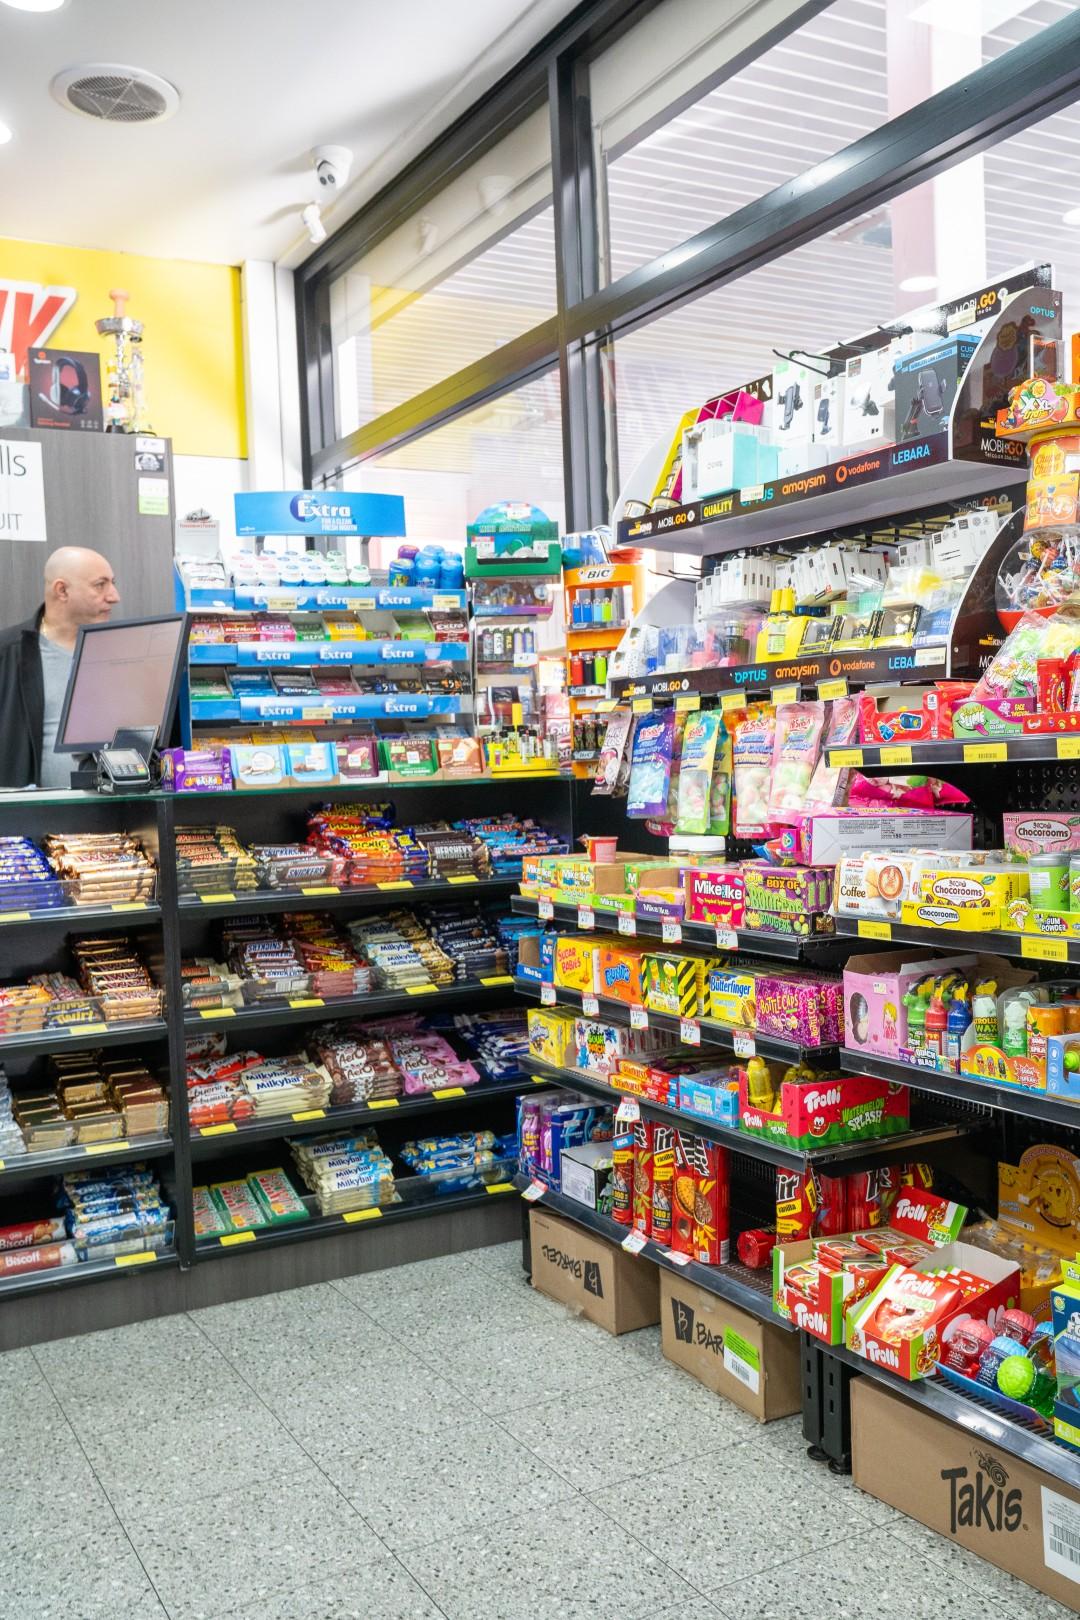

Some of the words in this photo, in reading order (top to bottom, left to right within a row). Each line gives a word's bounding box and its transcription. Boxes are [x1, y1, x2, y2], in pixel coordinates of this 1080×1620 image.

[1030, 306, 1055, 318] OPTUS
[892, 444, 930, 465] LEBARA
[848, 461, 880, 476] vodafone
[782, 474, 826, 497] amaysim
[298, 500, 351, 518] Extra
[703, 501, 733, 518] QUALITY
[379, 593, 411, 605] Extra
[257, 649, 291, 661] Extra
[320, 648, 353, 660] Extra
[382, 647, 414, 659] Extra
[842, 660, 875, 671] vodafone
[888, 656, 927, 669] LEBA
[735, 668, 767, 683] OPTUS
[775, 663, 820, 681] amaysim
[260, 704, 294, 716] Extra
[385, 702, 417, 713] Extra
[1018, 828, 1069, 838] Chocorooms
[434, 845, 473, 858] HERSHEY'S
[287, 866, 326, 878] SNICKERS
[694, 880, 721, 896] Mike
[725, 885, 743, 900] Ike
[767, 879, 785, 889] BOX
[787, 880, 799, 889] OF
[840, 885, 866, 898] Coffee
[934, 885, 983, 897] Chocorooms
[919, 908, 959, 919] Chocorooms
[1047, 916, 1061, 925] GUM
[1041, 924, 1067, 932] POWDER
[380, 943, 412, 952] Milkybar
[557, 948, 576, 961] SUGAR
[561, 959, 581, 974] BABIES
[710, 976, 751, 997] Butterfinger
[760, 996, 781, 1014] BOTTLE
[781, 993, 799, 1010] CAPS
[975, 1024, 998, 1032] WAX
[405, 1057, 430, 1071] Aero
[347, 1065, 372, 1078] Aero
[421, 1068, 446, 1085] Aero
[256, 1076, 301, 1091] Milkybar
[803, 1086, 842, 1113] Trolli
[842, 1097, 885, 1123] WATERMELON
[743, 1111, 763, 1128] Trolli
[848, 1109, 883, 1131] SPLASH
[313, 1142, 348, 1155] Milkybar
[327, 1155, 362, 1169] Milkybar
[657, 1153, 674, 1163] vanilla
[335, 1165, 371, 1178] Milkybar
[336, 1175, 374, 1190] Milkybar
[778, 1204, 797, 1213] vanilla
[896, 1199, 930, 1222] Trolli
[5, 1251, 41, 1267] Biscoff
[898, 1273, 942, 1297] Trolli
[794, 1303, 828, 1335] Trolli
[866, 1341, 899, 1369] Trolli
[940, 1466, 1023, 1534] Takis
